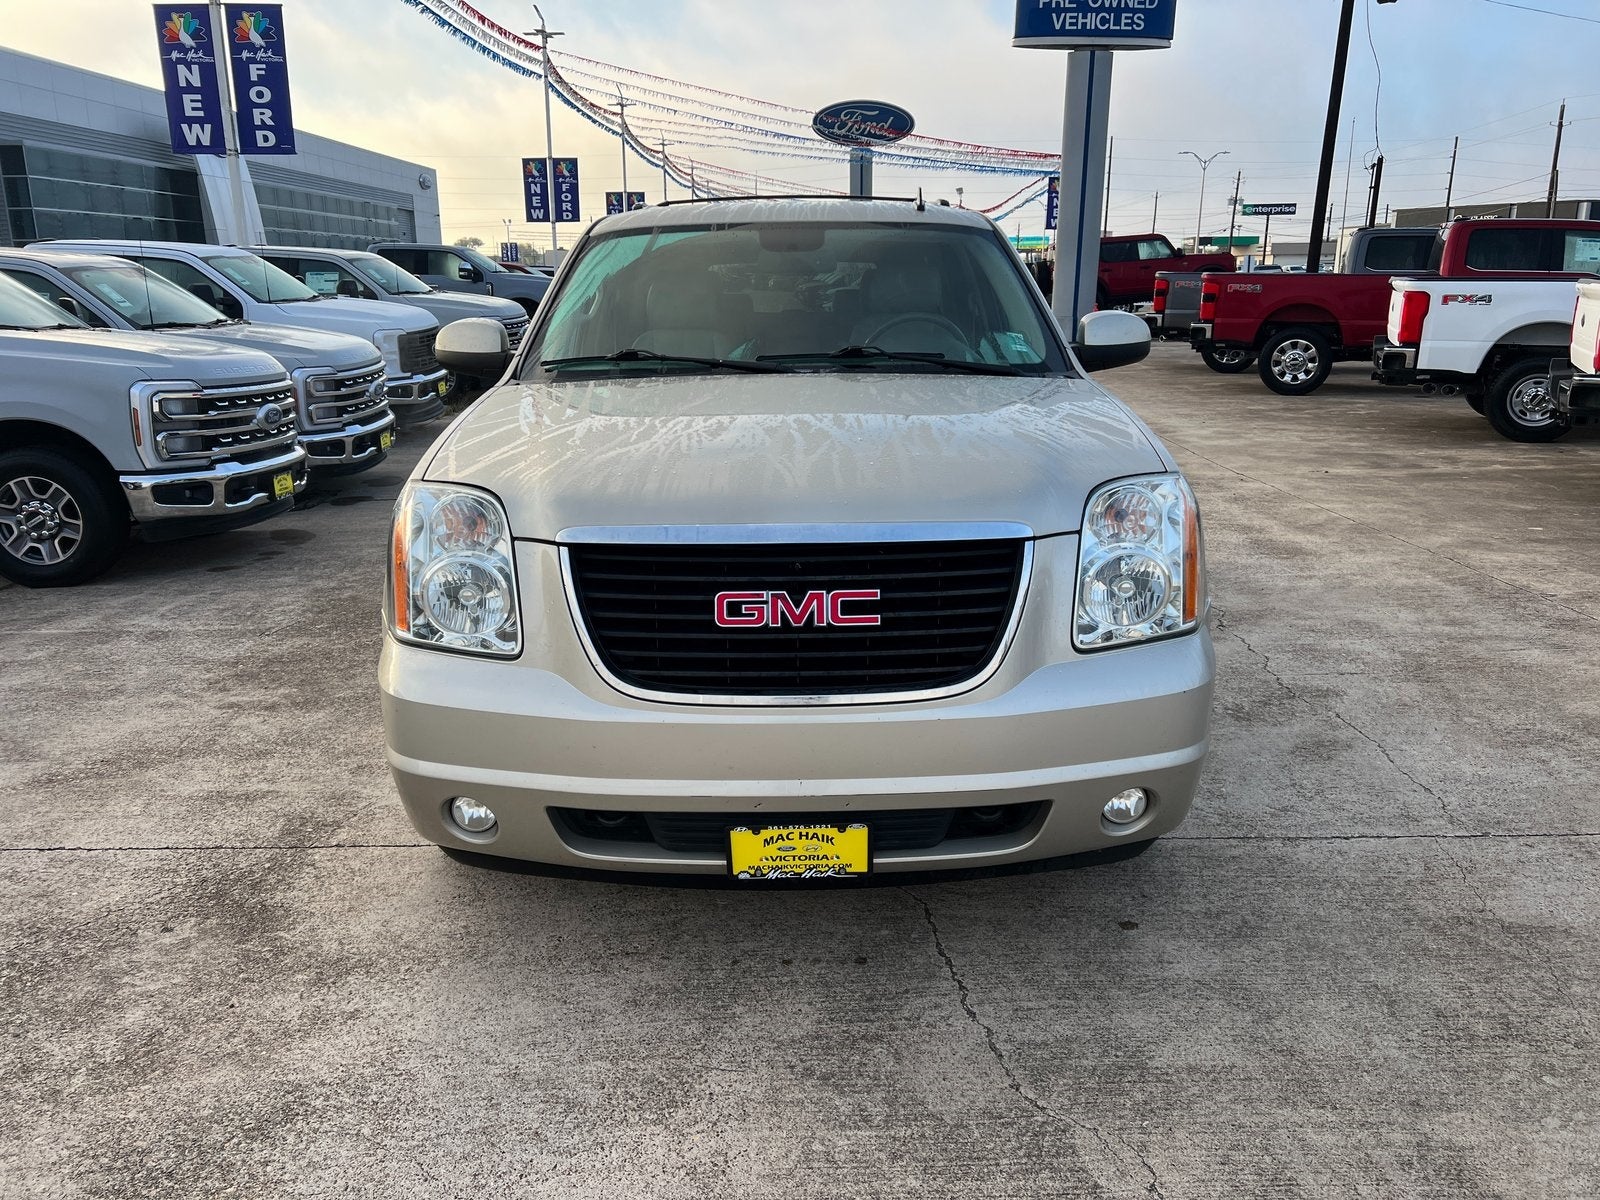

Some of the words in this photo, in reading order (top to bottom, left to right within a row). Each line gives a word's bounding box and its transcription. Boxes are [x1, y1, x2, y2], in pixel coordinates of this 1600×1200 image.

[1052, 12, 1145, 30] VEHICLES
[176, 64, 212, 146] NEW
[248, 63, 277, 147] FORD
[530, 183, 545, 220] NEW
[561, 183, 573, 220] FORD
[1245, 205, 1296, 214] enterprise
[1227, 283, 1262, 293] FX4
[1441, 293, 1493, 306] FX4
[714, 589, 881, 628] GMC
[763, 831, 795, 848] MAC
[798, 831, 835, 846] HAIK
[769, 854, 830, 862] VICTORIA
[747, 863, 853, 871] MACHAIKVICTORIA.COM
[765, 868, 798, 880] Mac
[800, 867, 840, 879] Haik
